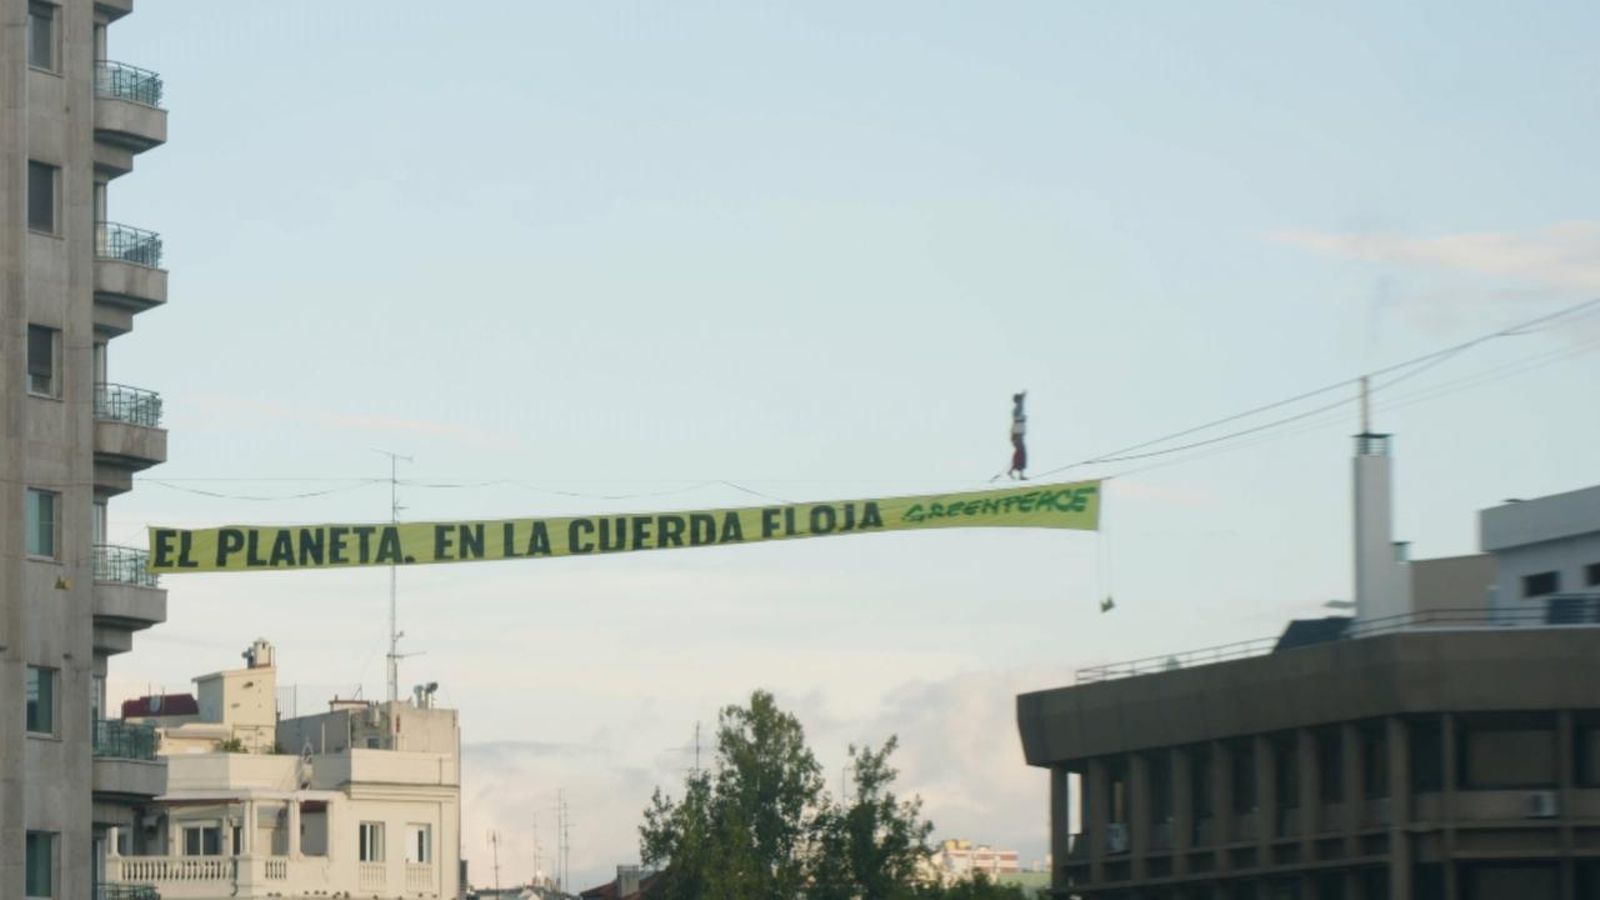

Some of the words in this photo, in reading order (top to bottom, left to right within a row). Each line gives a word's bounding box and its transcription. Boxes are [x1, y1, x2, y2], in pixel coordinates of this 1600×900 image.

[902, 486, 1097, 523] GREENPEACE
[154, 529, 199, 568] EL
[215, 526, 416, 568] PLANETA.
[434, 524, 485, 561] EN
[503, 521, 552, 558] LA
[568, 512, 744, 555] CUERDA
[762, 502, 883, 539] FLOJA
